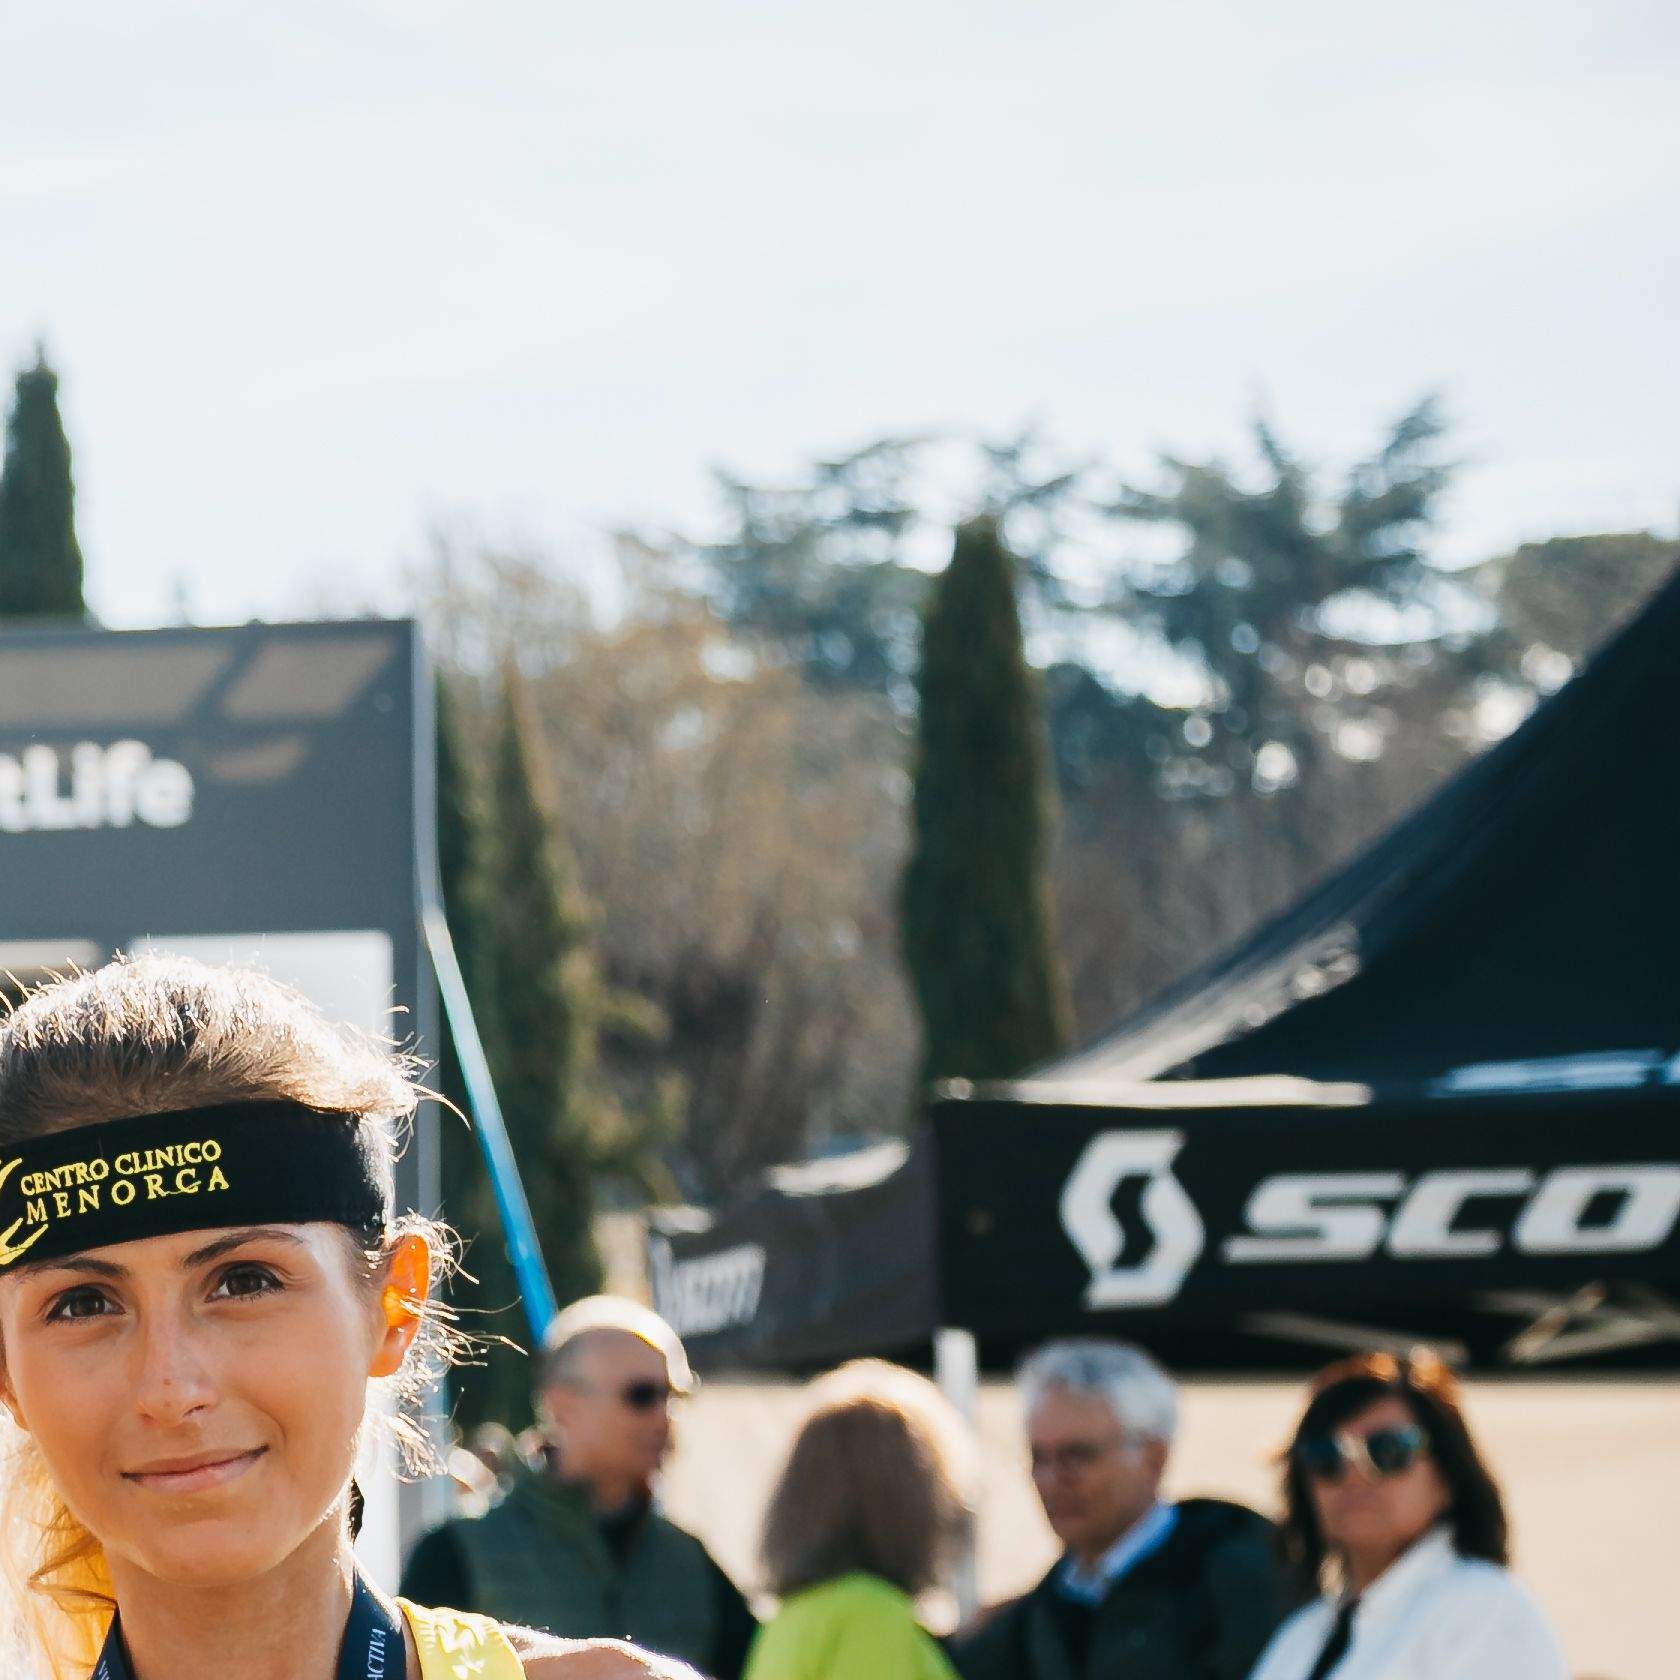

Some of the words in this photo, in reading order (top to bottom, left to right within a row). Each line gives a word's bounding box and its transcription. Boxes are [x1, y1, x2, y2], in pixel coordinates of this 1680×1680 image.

[20, 1158, 110, 1197] CENTRO
[114, 1139, 222, 1175] CLINICO
[26, 1165, 230, 1225] MENORCA
